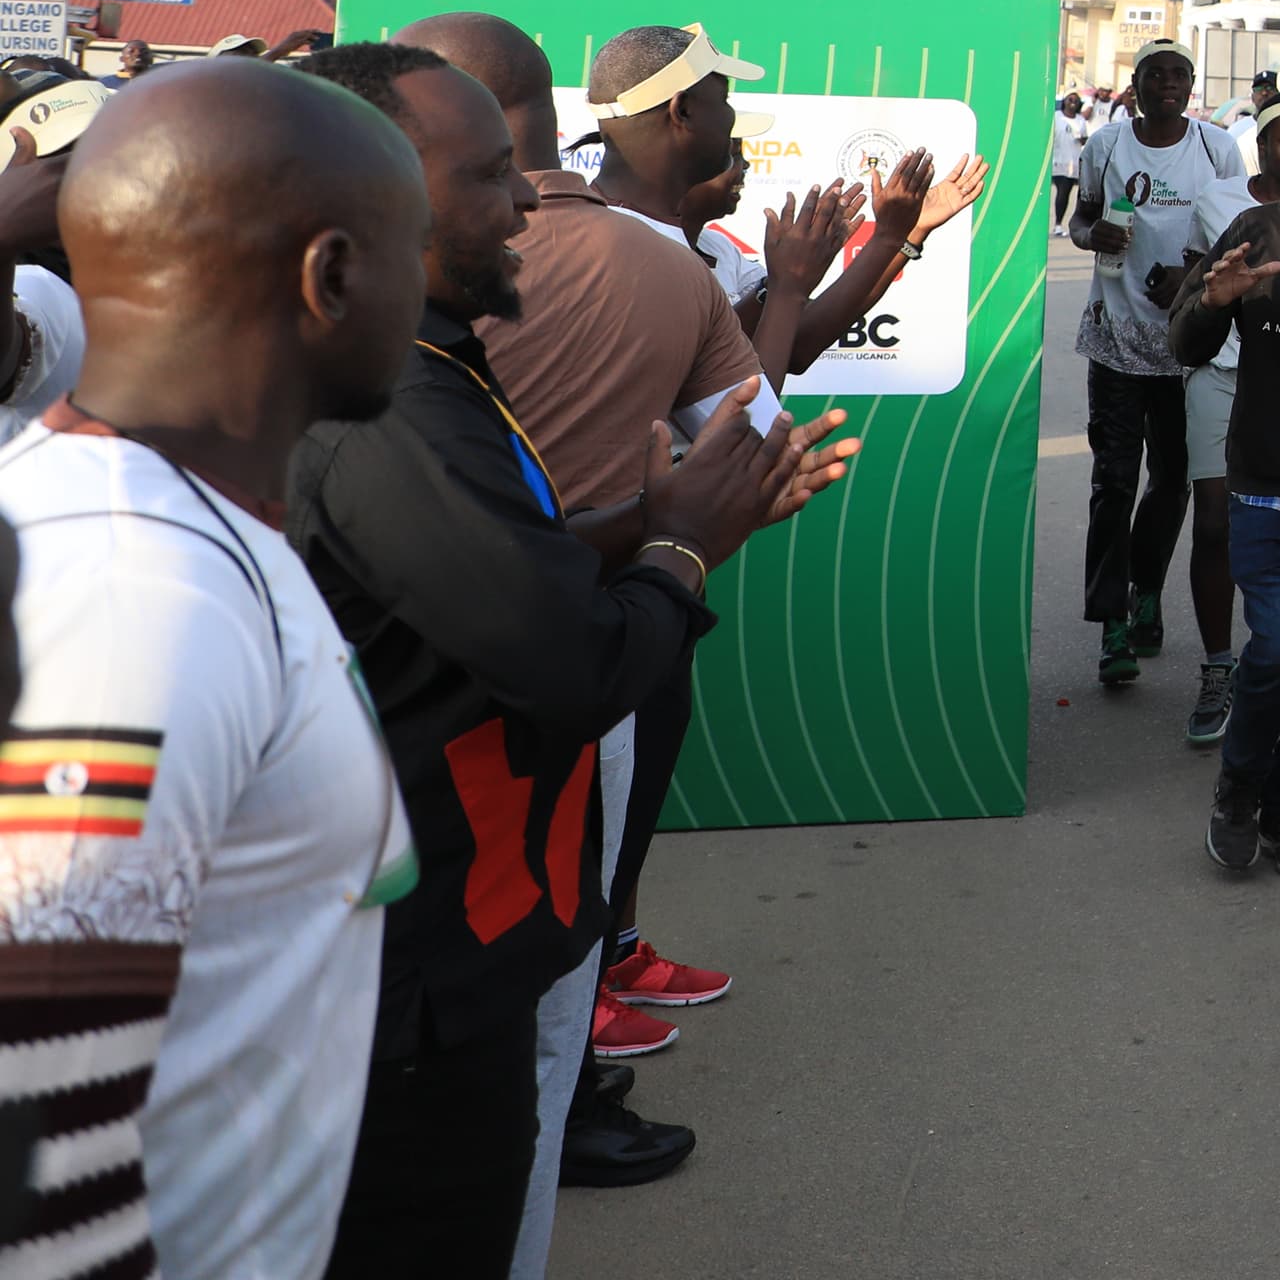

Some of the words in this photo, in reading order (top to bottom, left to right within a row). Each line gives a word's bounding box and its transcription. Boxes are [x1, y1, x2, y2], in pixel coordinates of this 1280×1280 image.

[1152, 179, 1168, 188] The
[1151, 188, 1178, 198] Coffee
[1150, 197, 1192, 207] Marathon
[855, 352, 898, 361] UGANDA
